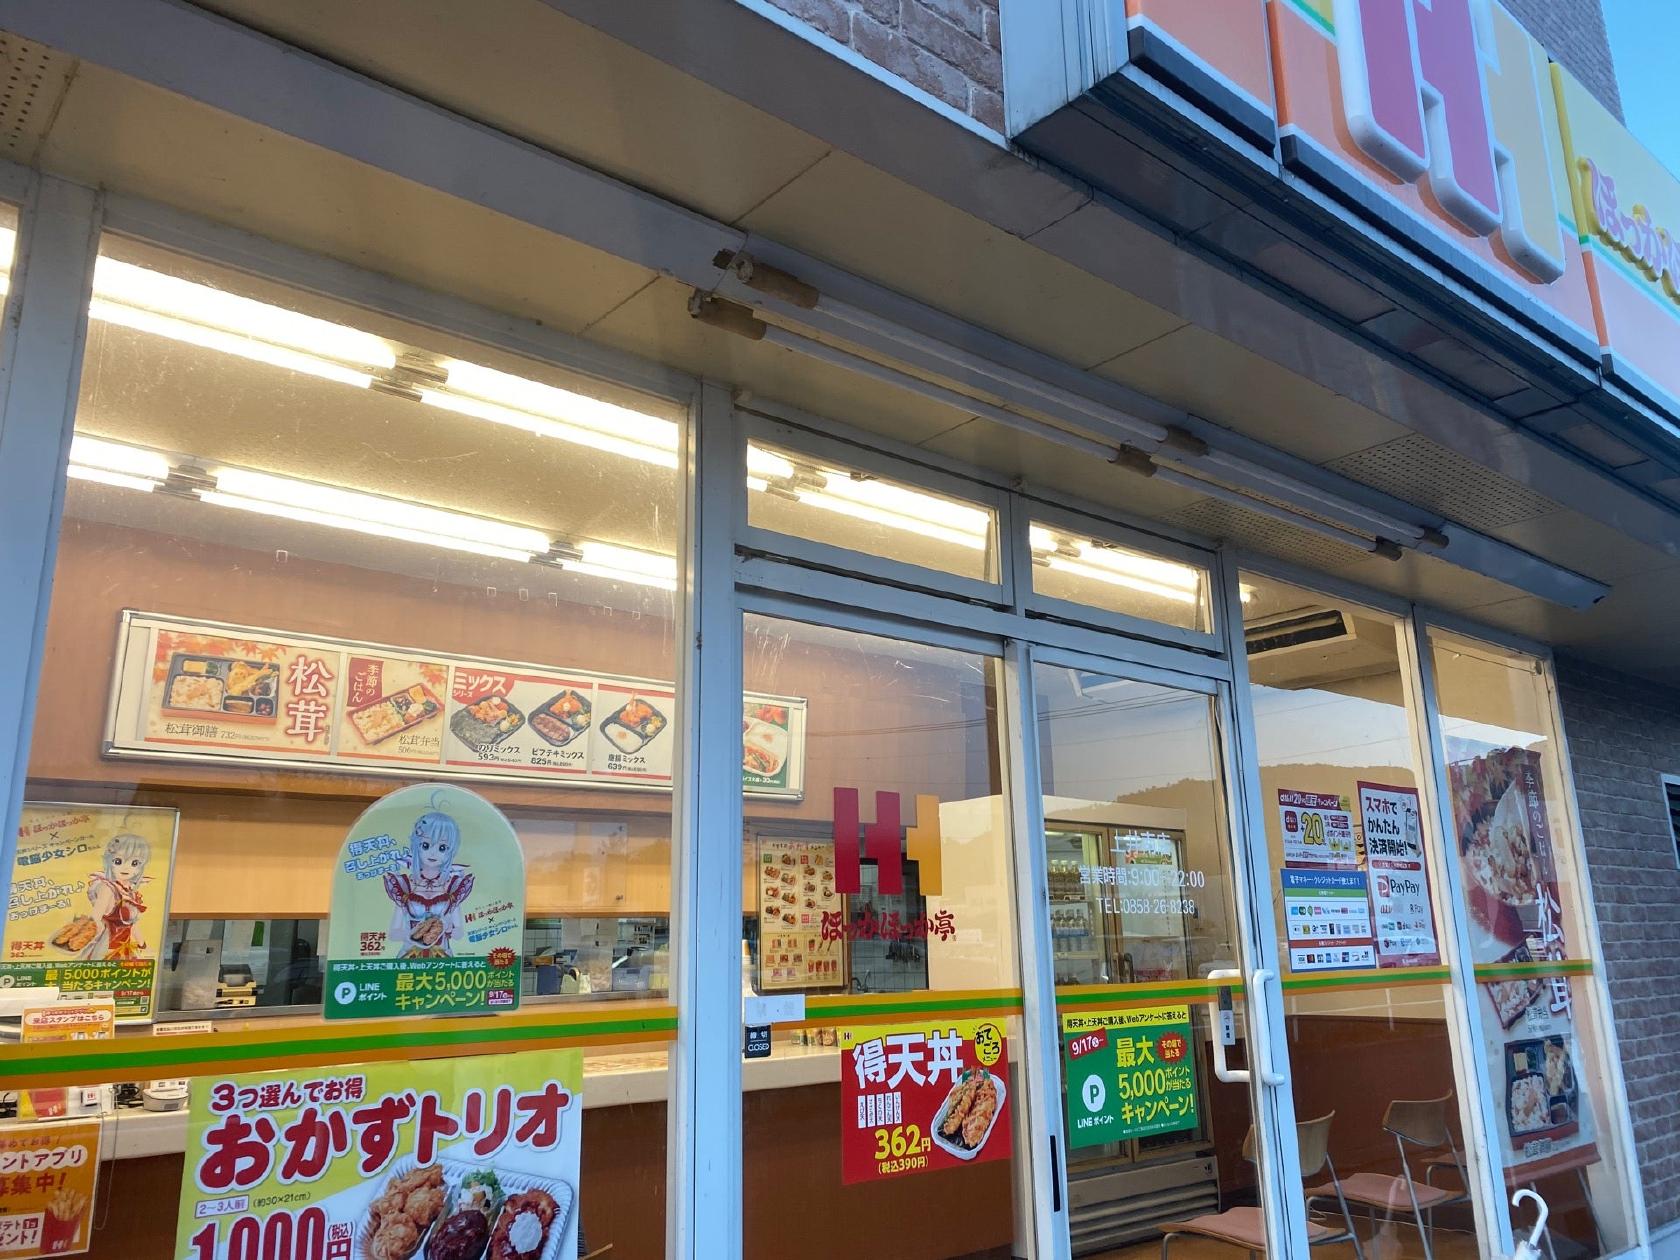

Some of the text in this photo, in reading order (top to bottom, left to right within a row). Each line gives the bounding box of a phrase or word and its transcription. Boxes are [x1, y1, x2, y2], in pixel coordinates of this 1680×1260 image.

[351, 671, 363, 703] ごはん
[454, 672, 506, 694] ミックス
[286, 656, 333, 742] 松茸
[531, 747, 585, 760] ビフテキミックス
[1365, 796, 1398, 815] スマホで
[1367, 817, 1400, 835] かんたん
[1368, 837, 1408, 857] 決済開始!
[1391, 879, 1420, 896] PayPay
[821, 909, 956, 942] ほっかほっか亭
[487, 970, 515, 979] ポイント
[487, 978, 515, 988] が当たる
[358, 991, 388, 1001] ポイント
[359, 982, 380, 991] LINE
[395, 990, 485, 1011] キャンペーン!
[747, 1043, 770, 1052] CLOSED
[1116, 1036, 1155, 1067] 最大
[852, 1029, 964, 1090] 得天丼
[1165, 1066, 1191, 1079] ポイント
[1118, 1068, 1166, 1099] 5,000
[1166, 1079, 1192, 1091] が当たる
[211, 1076, 363, 1112] 3つ選んでお得
[1121, 1093, 1195, 1125] キャンペーン!
[1077, 1114, 1115, 1129] LINE ポイント
[198, 1082, 570, 1190] おかずトリオ
[874, 1124, 931, 1160] 362円
[327, 1221, 354, 1240] (税込)
